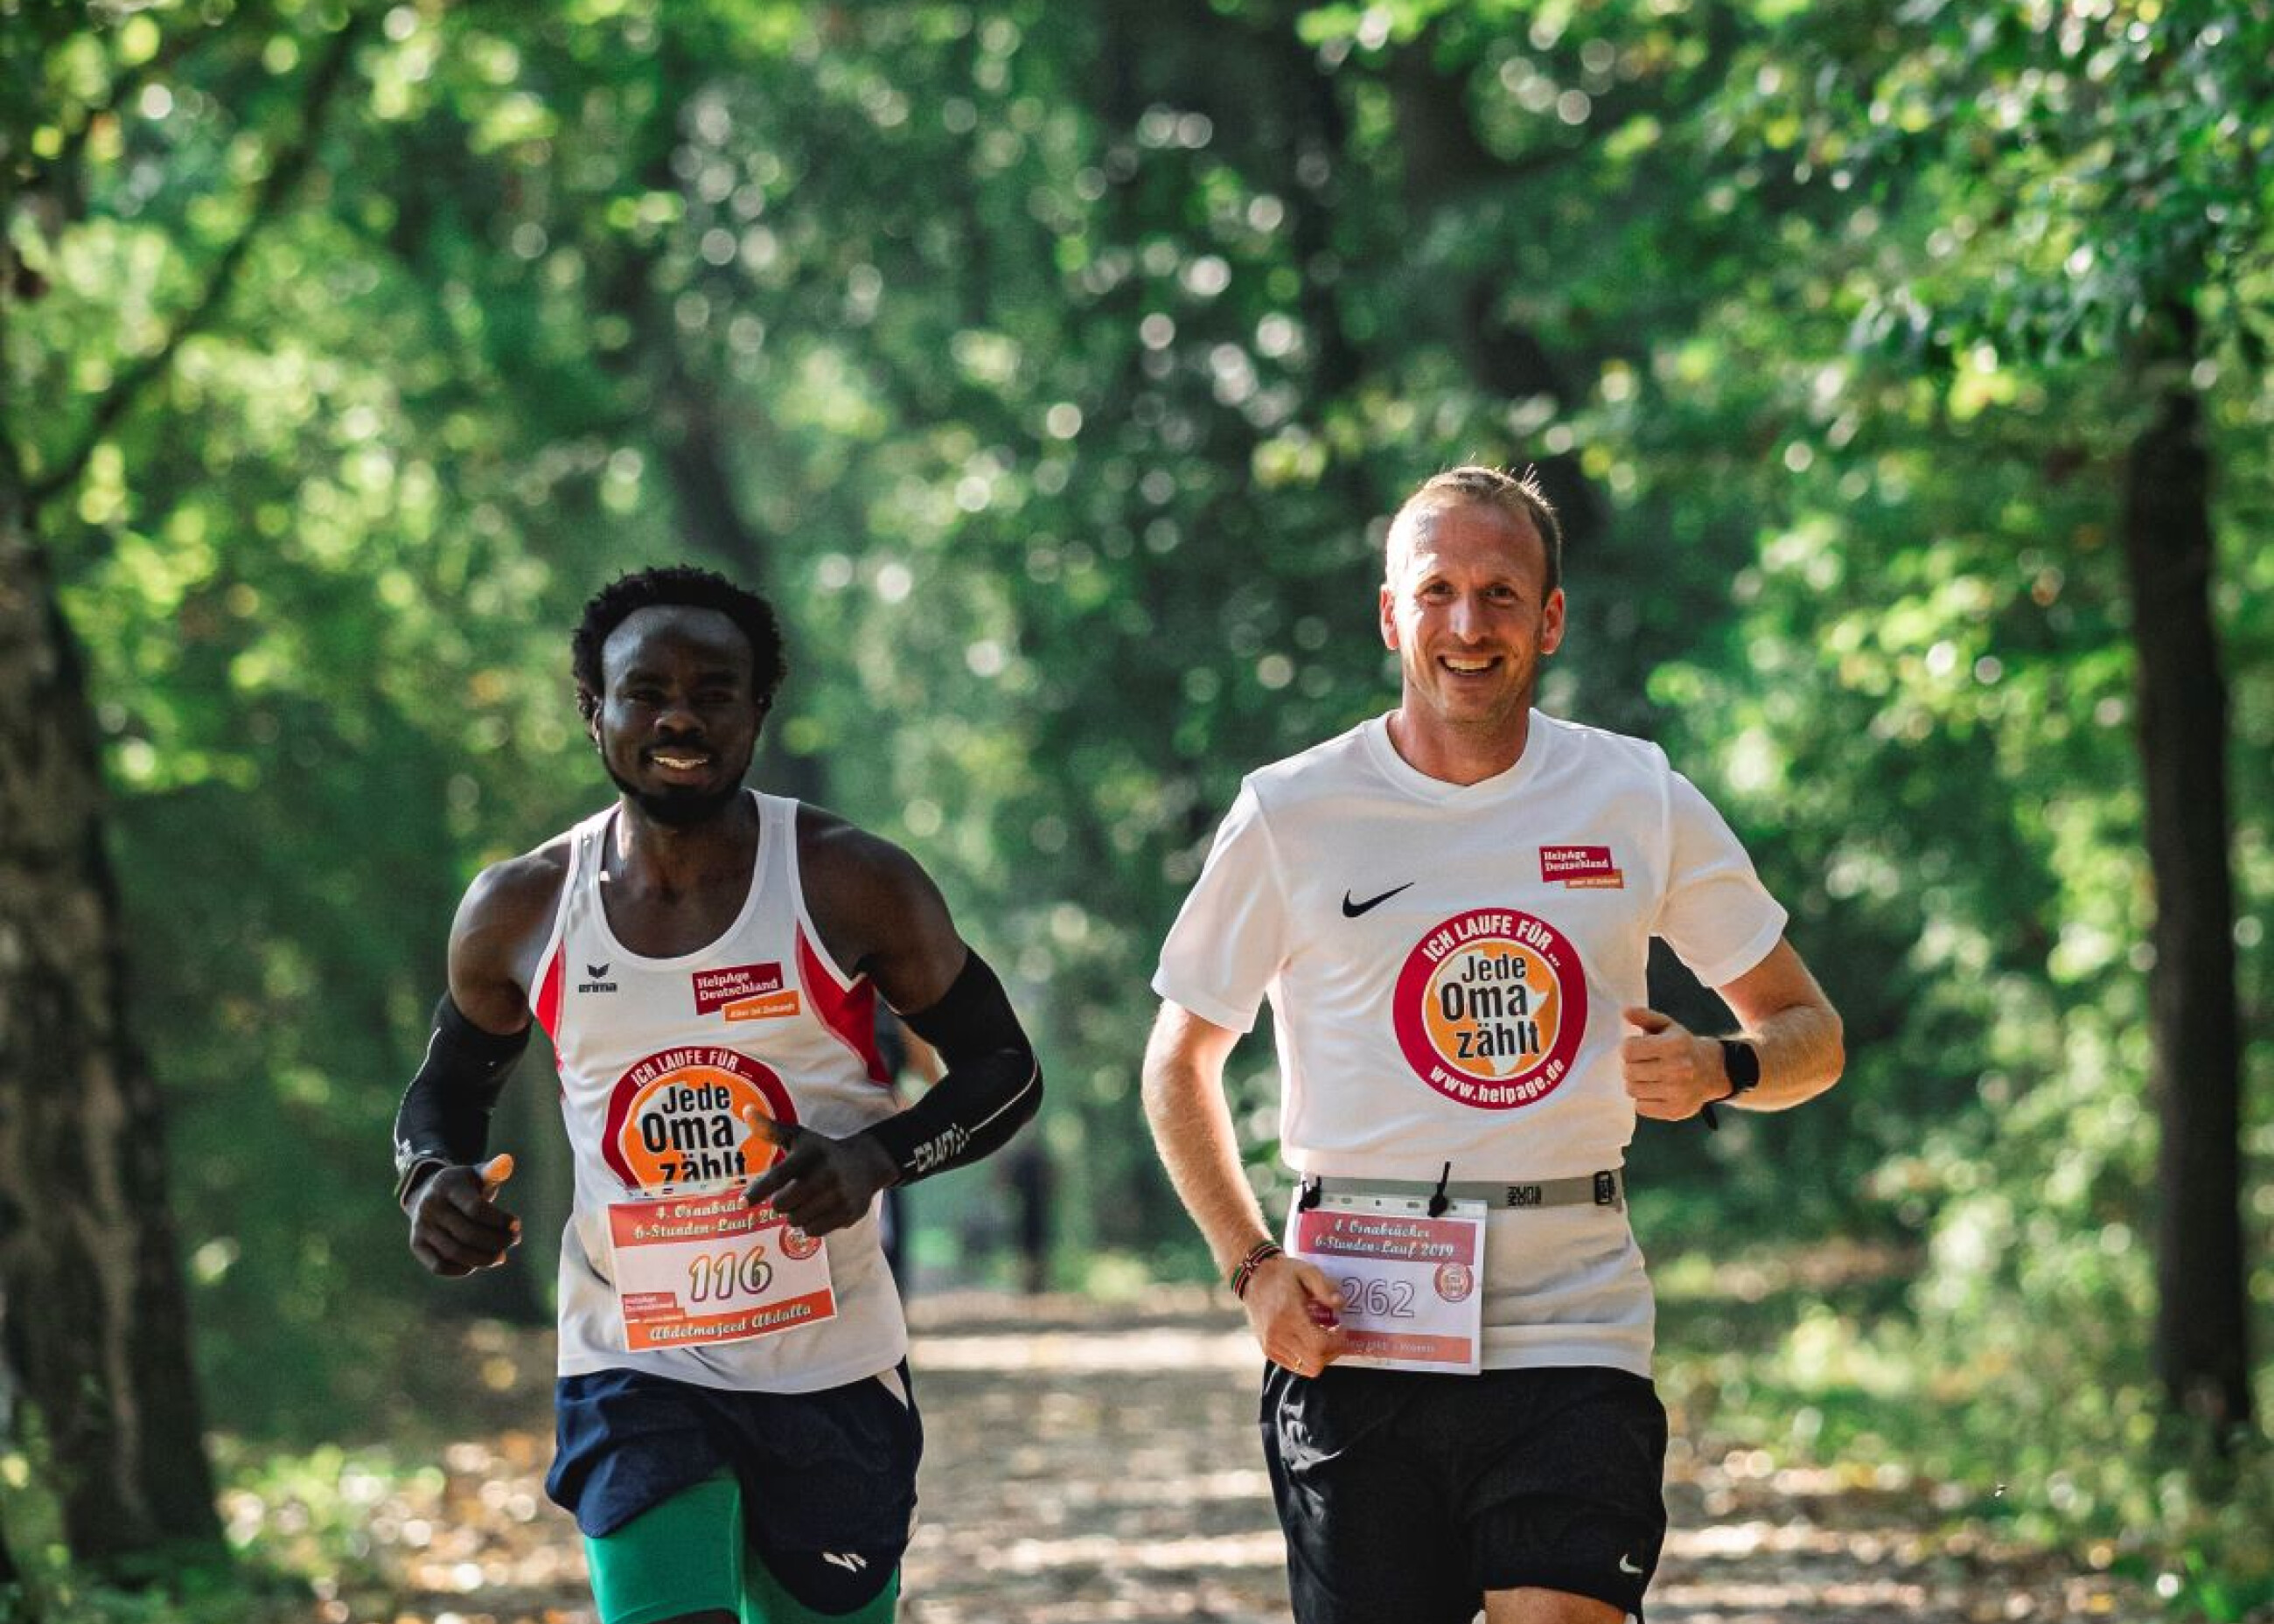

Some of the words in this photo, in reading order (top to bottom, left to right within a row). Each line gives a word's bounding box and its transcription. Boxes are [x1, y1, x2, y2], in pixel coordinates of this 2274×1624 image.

[1422, 930, 1455, 962] ICH
[1454, 915, 1512, 940] LAUFE
[1516, 919, 1553, 951] FÜR
[697, 972, 751, 989] HelpAge
[1461, 952, 1526, 983] Jede
[578, 982, 617, 993] erima
[700, 978, 778, 1001] Deutschland
[1440, 982, 1529, 1021] Oma
[1455, 1021, 1539, 1058] zählt
[631, 1063, 657, 1088] ICH
[656, 1049, 703, 1073] LAUFE
[1431, 1058, 1565, 1105] www.helpage.de
[661, 1082, 731, 1114] Jede
[642, 1113, 734, 1154] Oma
[688, 1245, 772, 1302] 116
[1342, 1277, 1415, 1318] 262
